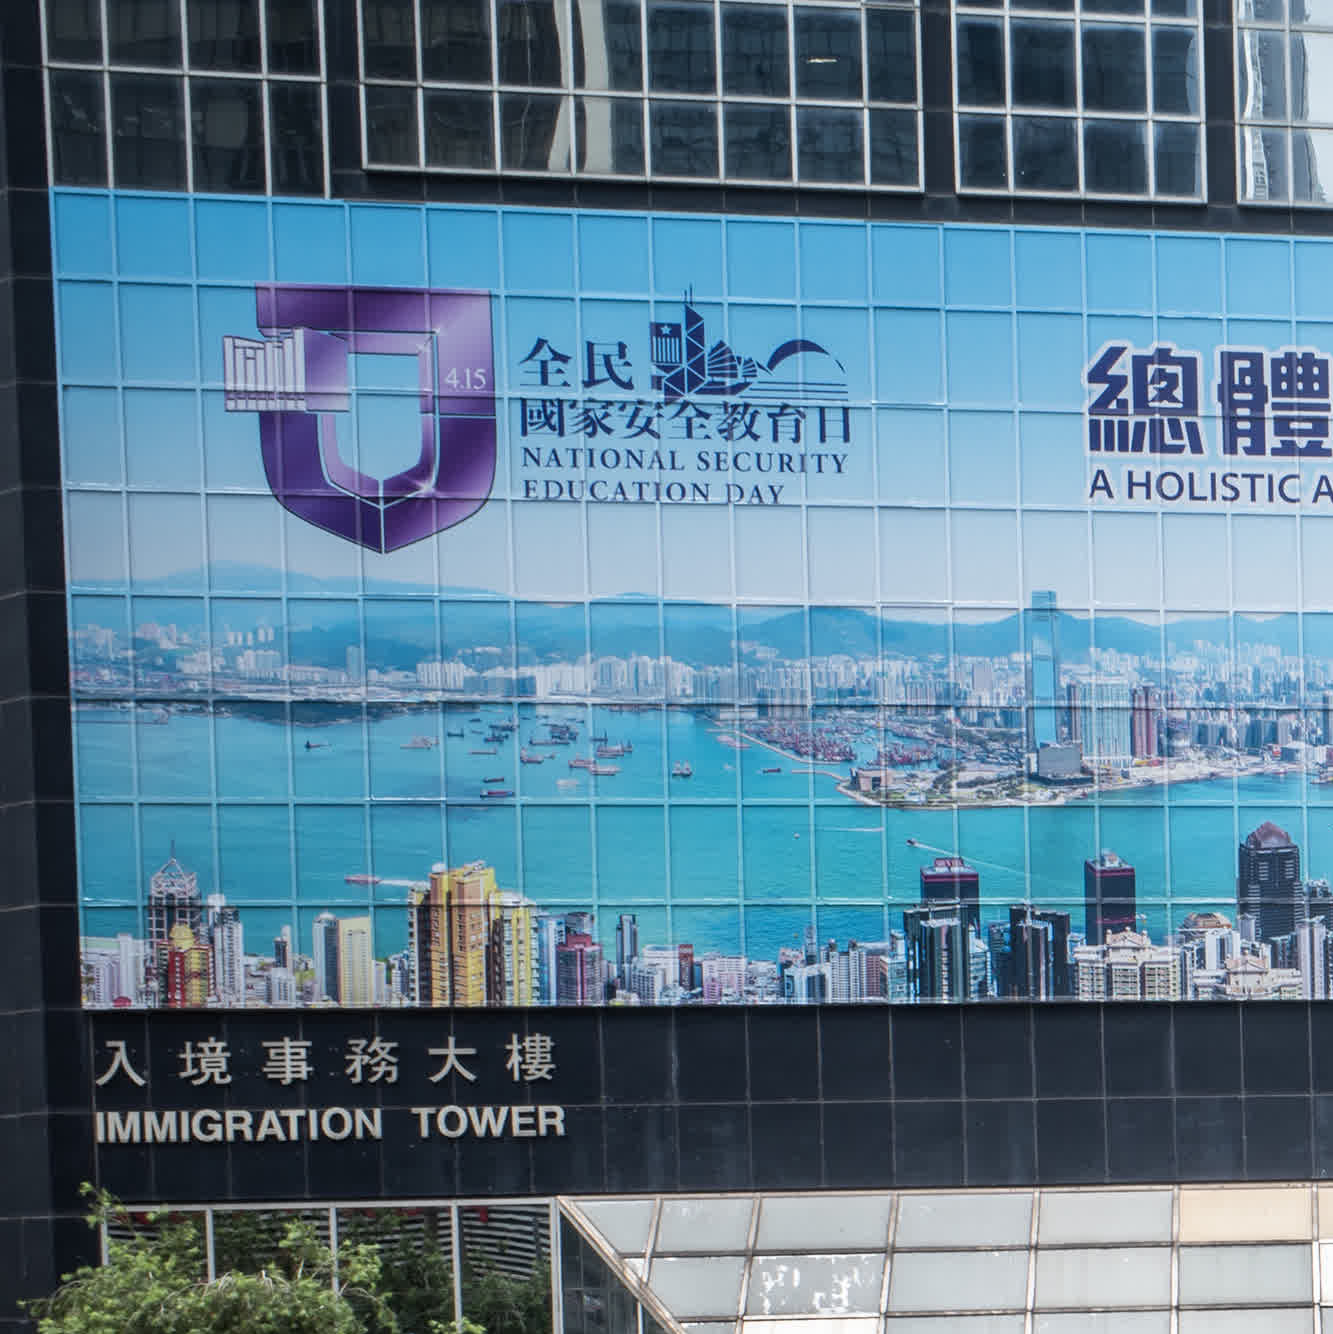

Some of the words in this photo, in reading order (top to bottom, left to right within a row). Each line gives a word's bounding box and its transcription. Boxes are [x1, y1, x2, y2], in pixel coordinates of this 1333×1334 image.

[443, 367, 487, 390] 4.15
[518, 337, 635, 391] 全民
[519, 396, 850, 443] 國家安全教育日
[521, 447, 685, 471] NATIONAL
[696, 450, 848, 473] SECURITY
[523, 480, 710, 503] EDUCATION
[726, 484, 785, 505] DAY
[1089, 469, 1114, 499] A
[1127, 470, 1302, 503] HOLISTIC
[96, 1033, 557, 1086] 入境事務大樓
[96, 1107, 382, 1144] IMMIGRATION
[411, 1105, 566, 1138] TOWER
